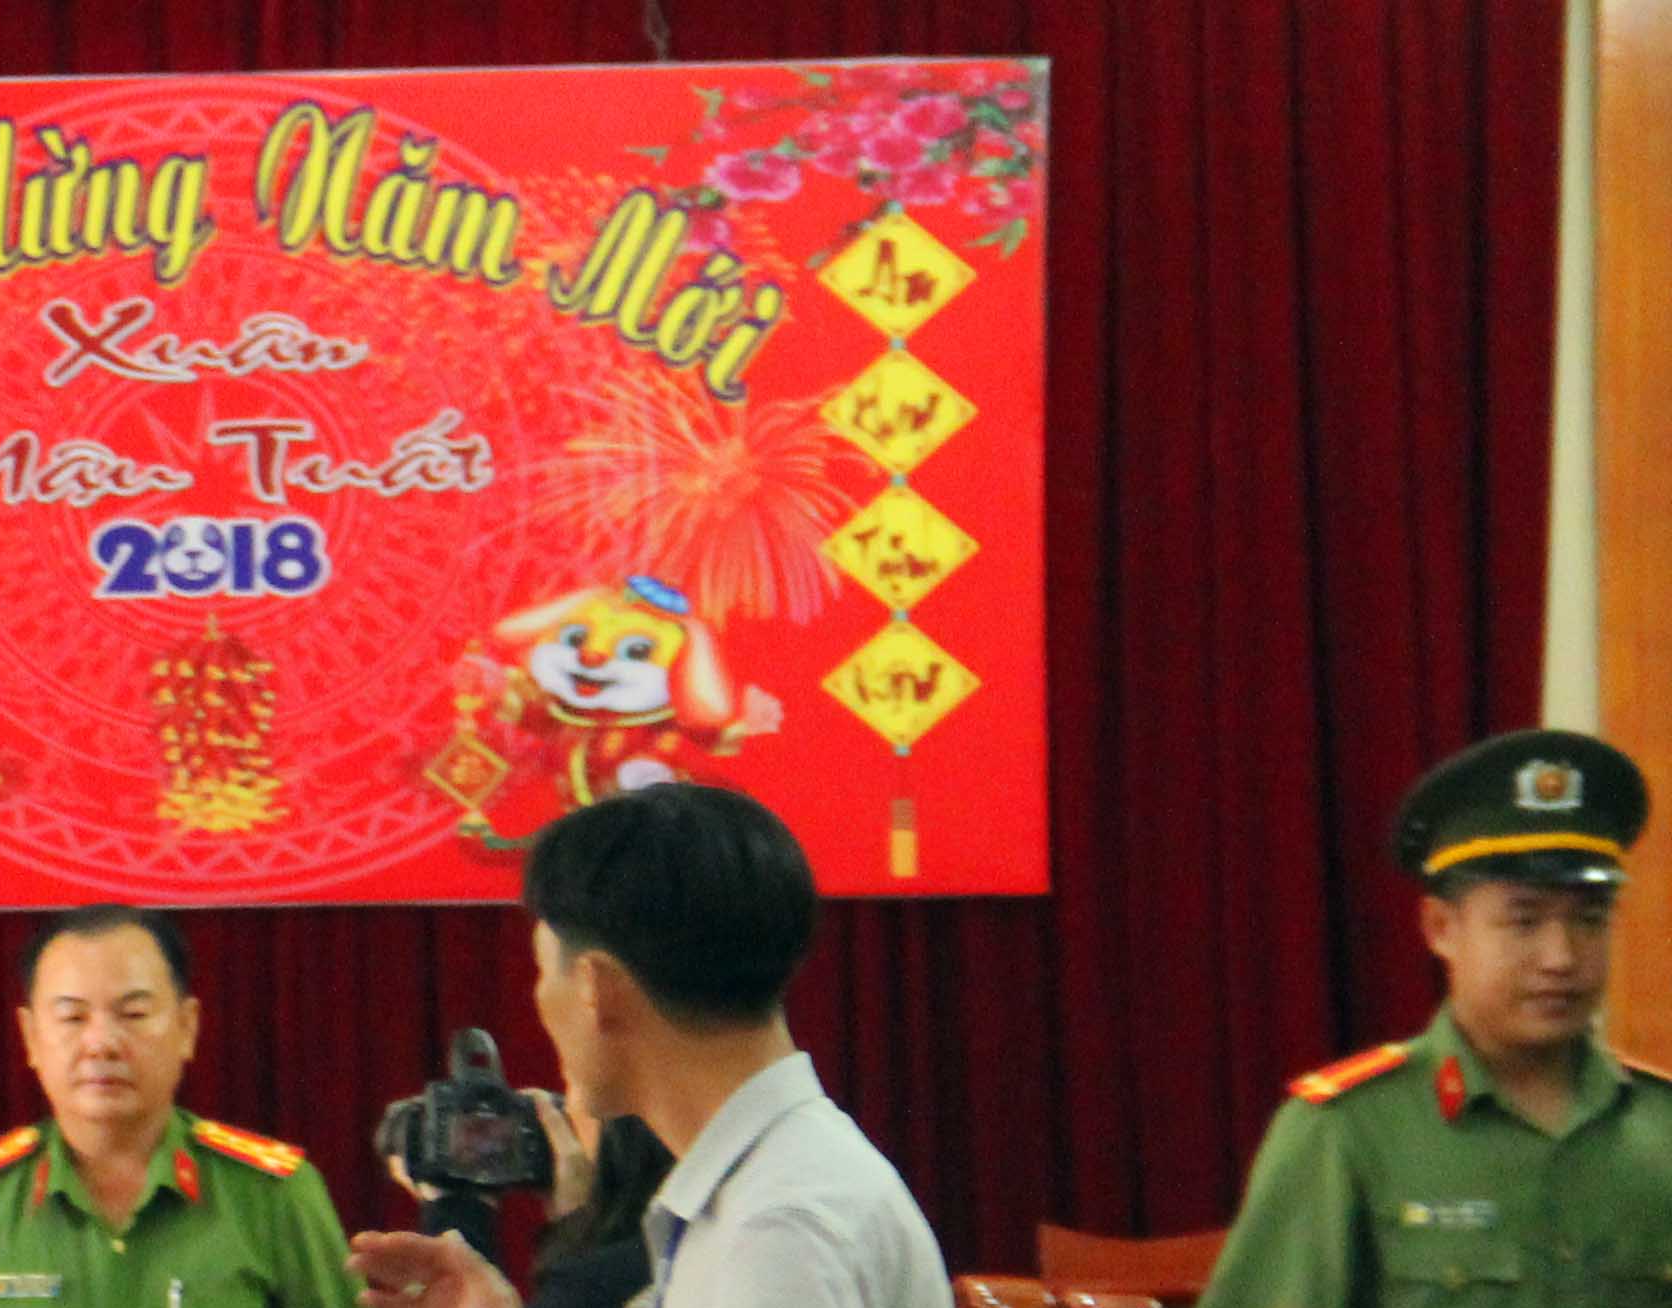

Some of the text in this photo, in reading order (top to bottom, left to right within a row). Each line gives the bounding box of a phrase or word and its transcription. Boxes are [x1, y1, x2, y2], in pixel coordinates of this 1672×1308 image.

[256, 99, 523, 285] Năm
[547, 188, 782, 403] Mới
[39, 297, 369, 387] Xuân
[208, 408, 494, 504] Tuất
[89, 514, 329, 599] 2018
